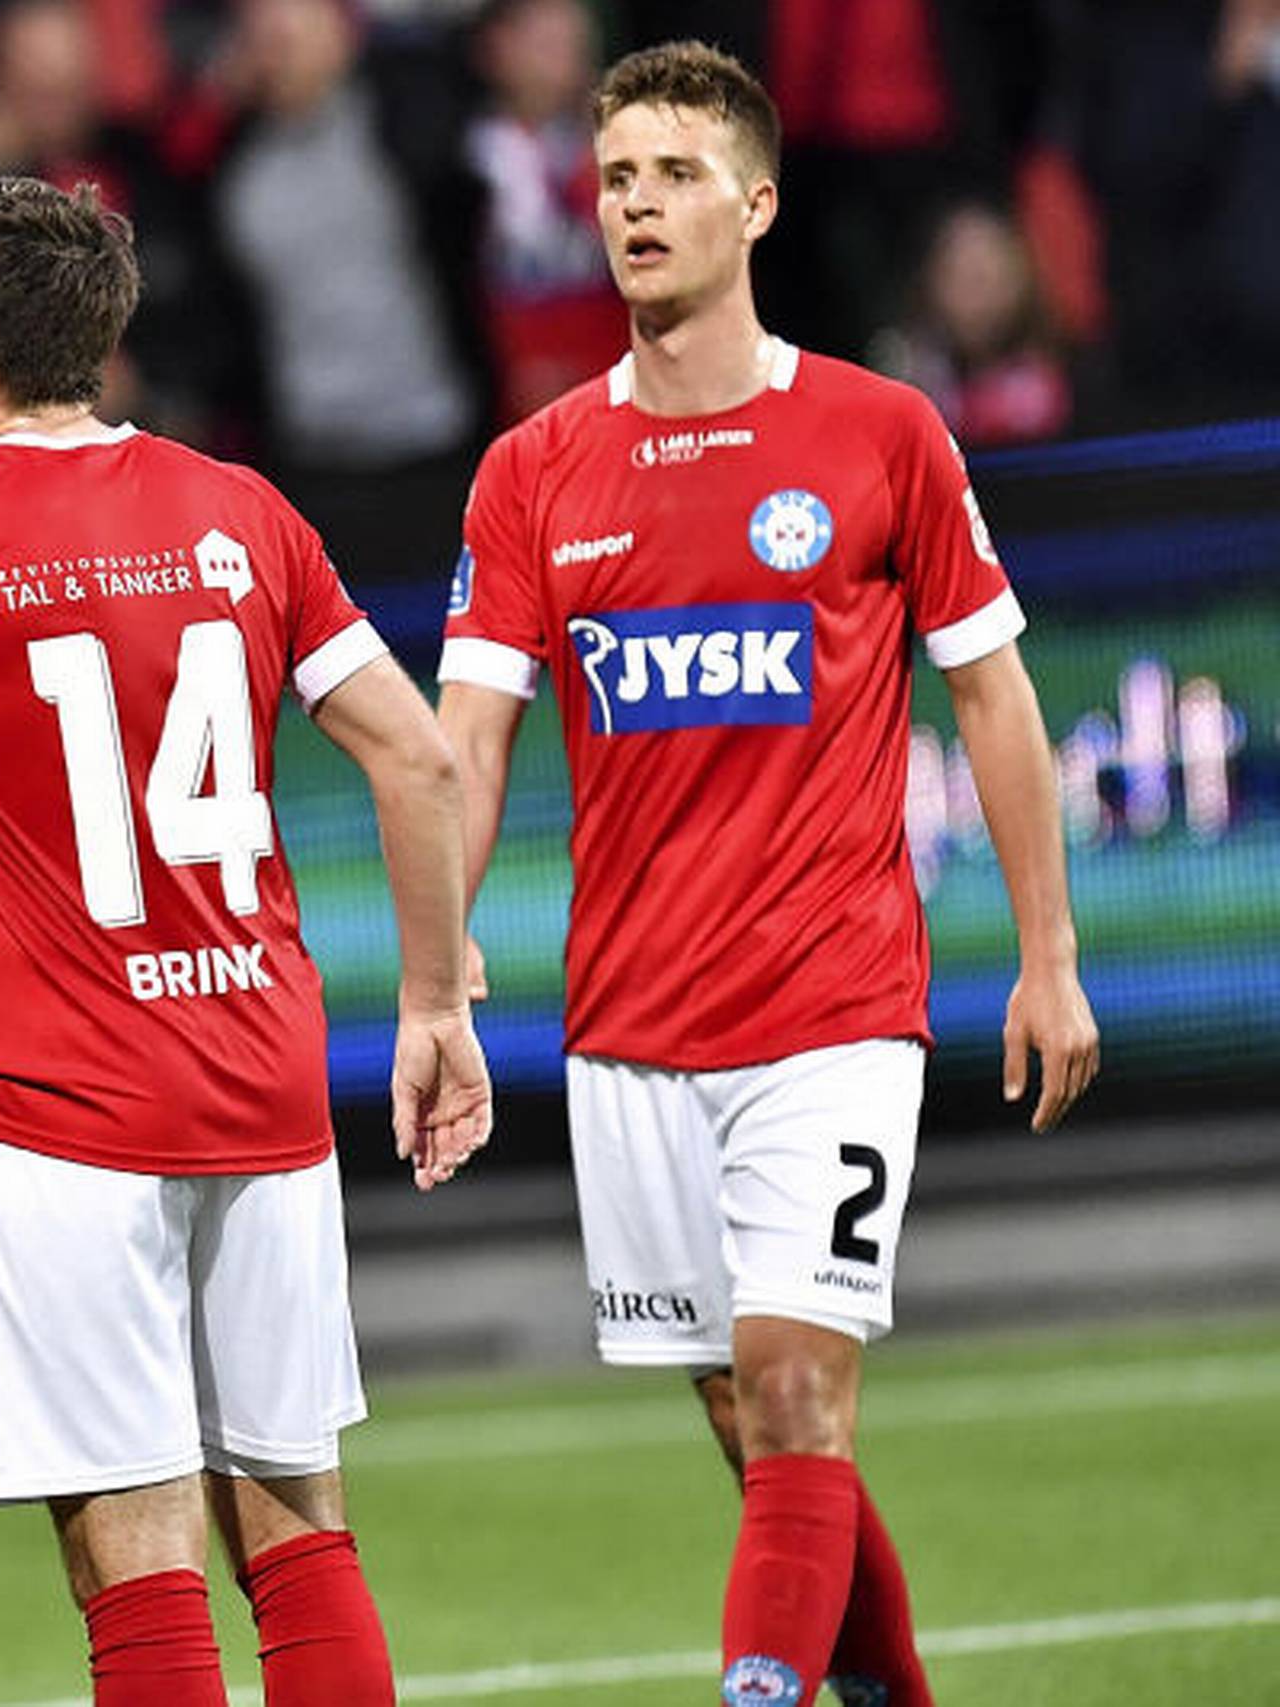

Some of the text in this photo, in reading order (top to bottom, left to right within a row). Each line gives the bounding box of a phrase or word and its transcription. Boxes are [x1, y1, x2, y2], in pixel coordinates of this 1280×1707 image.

[1, 566, 194, 612] TAL & TANKER
[618, 629, 805, 702] JYSK
[26, 619, 275, 928] 14
[125, 942, 275, 1001] BRINK
[830, 1142, 888, 1266] 2
